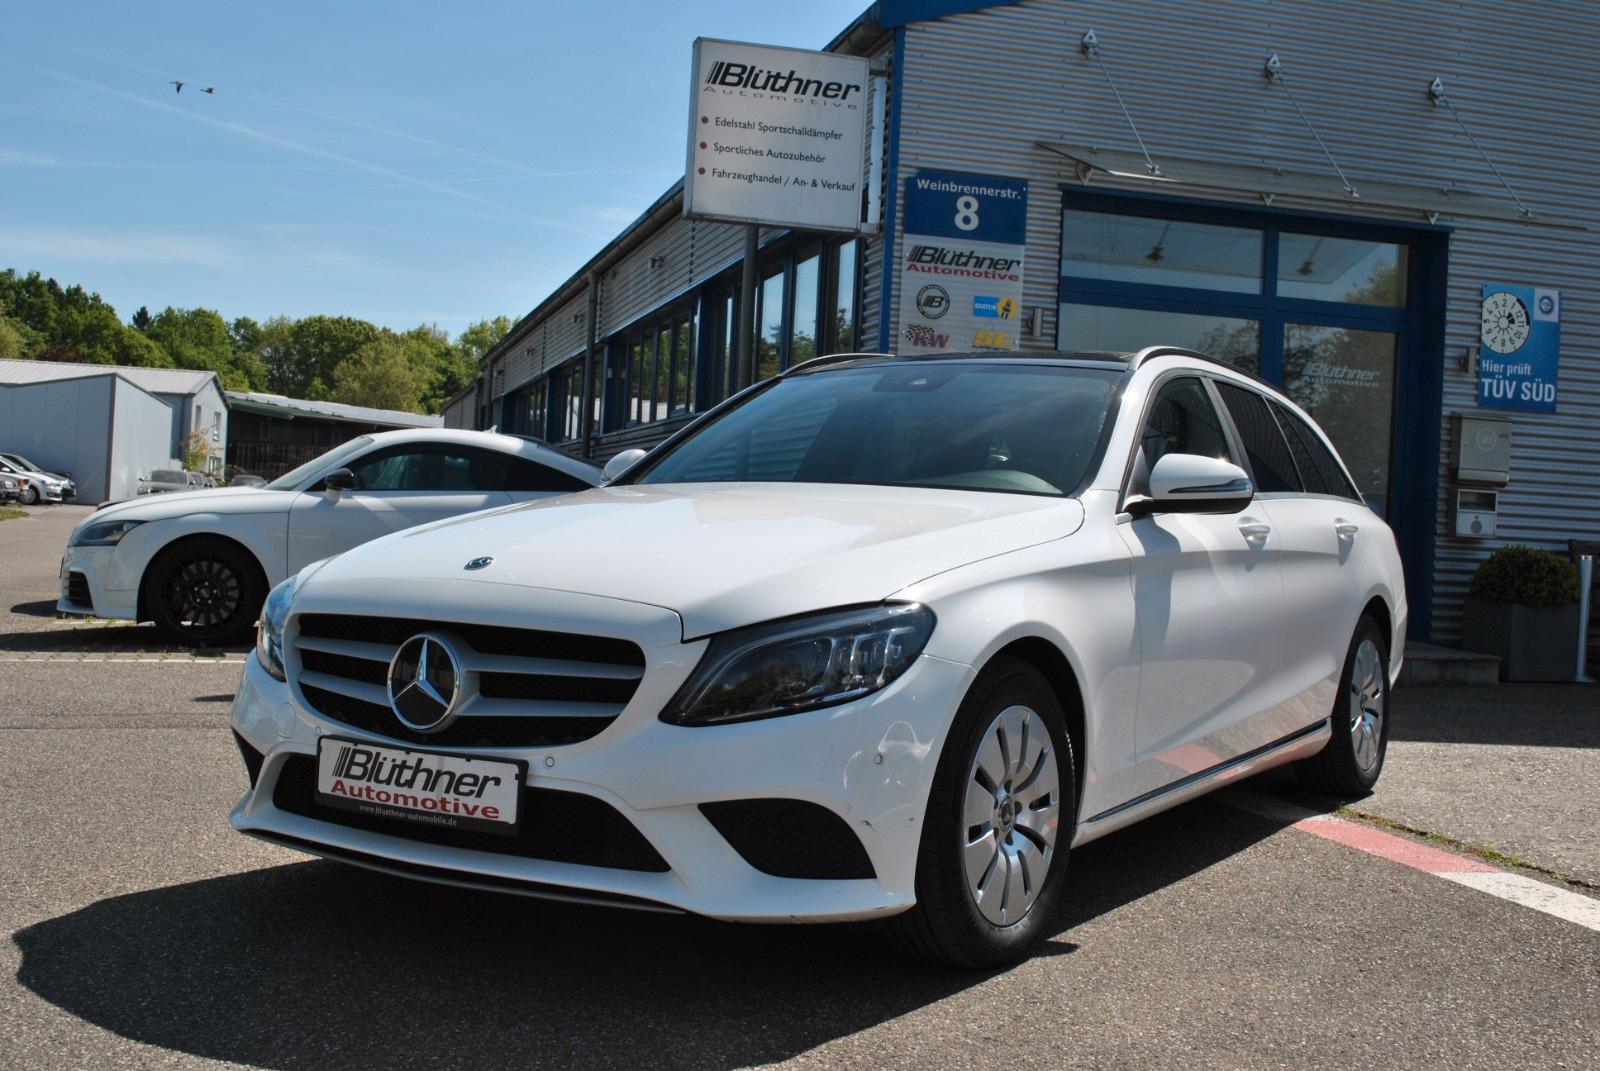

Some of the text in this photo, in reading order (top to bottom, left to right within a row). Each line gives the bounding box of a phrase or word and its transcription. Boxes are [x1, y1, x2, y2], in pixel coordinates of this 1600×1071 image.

[712, 61, 861, 100] Blüthner
[703, 86, 858, 109] Automotive
[715, 116, 843, 141] Edelstahl Sportschalldämpfer
[713, 142, 826, 163] Sportliches Autozubehör
[712, 167, 782, 184] Fahrzeughandel
[792, 176, 809, 187] An-
[811, 178, 818, 188] &
[821, 179, 856, 192] Verkauf
[917, 178, 1021, 199] Weinbrennerstr.
[954, 195, 980, 231] 8
[915, 246, 1021, 272] Blüthner
[906, 263, 1020, 282] Automotive
[1481, 359, 1532, 377] Hier prüft
[1481, 375, 1556, 402] TÜV SÜD
[341, 748, 502, 798] Blüthner
[331, 779, 500, 819] Automotive
